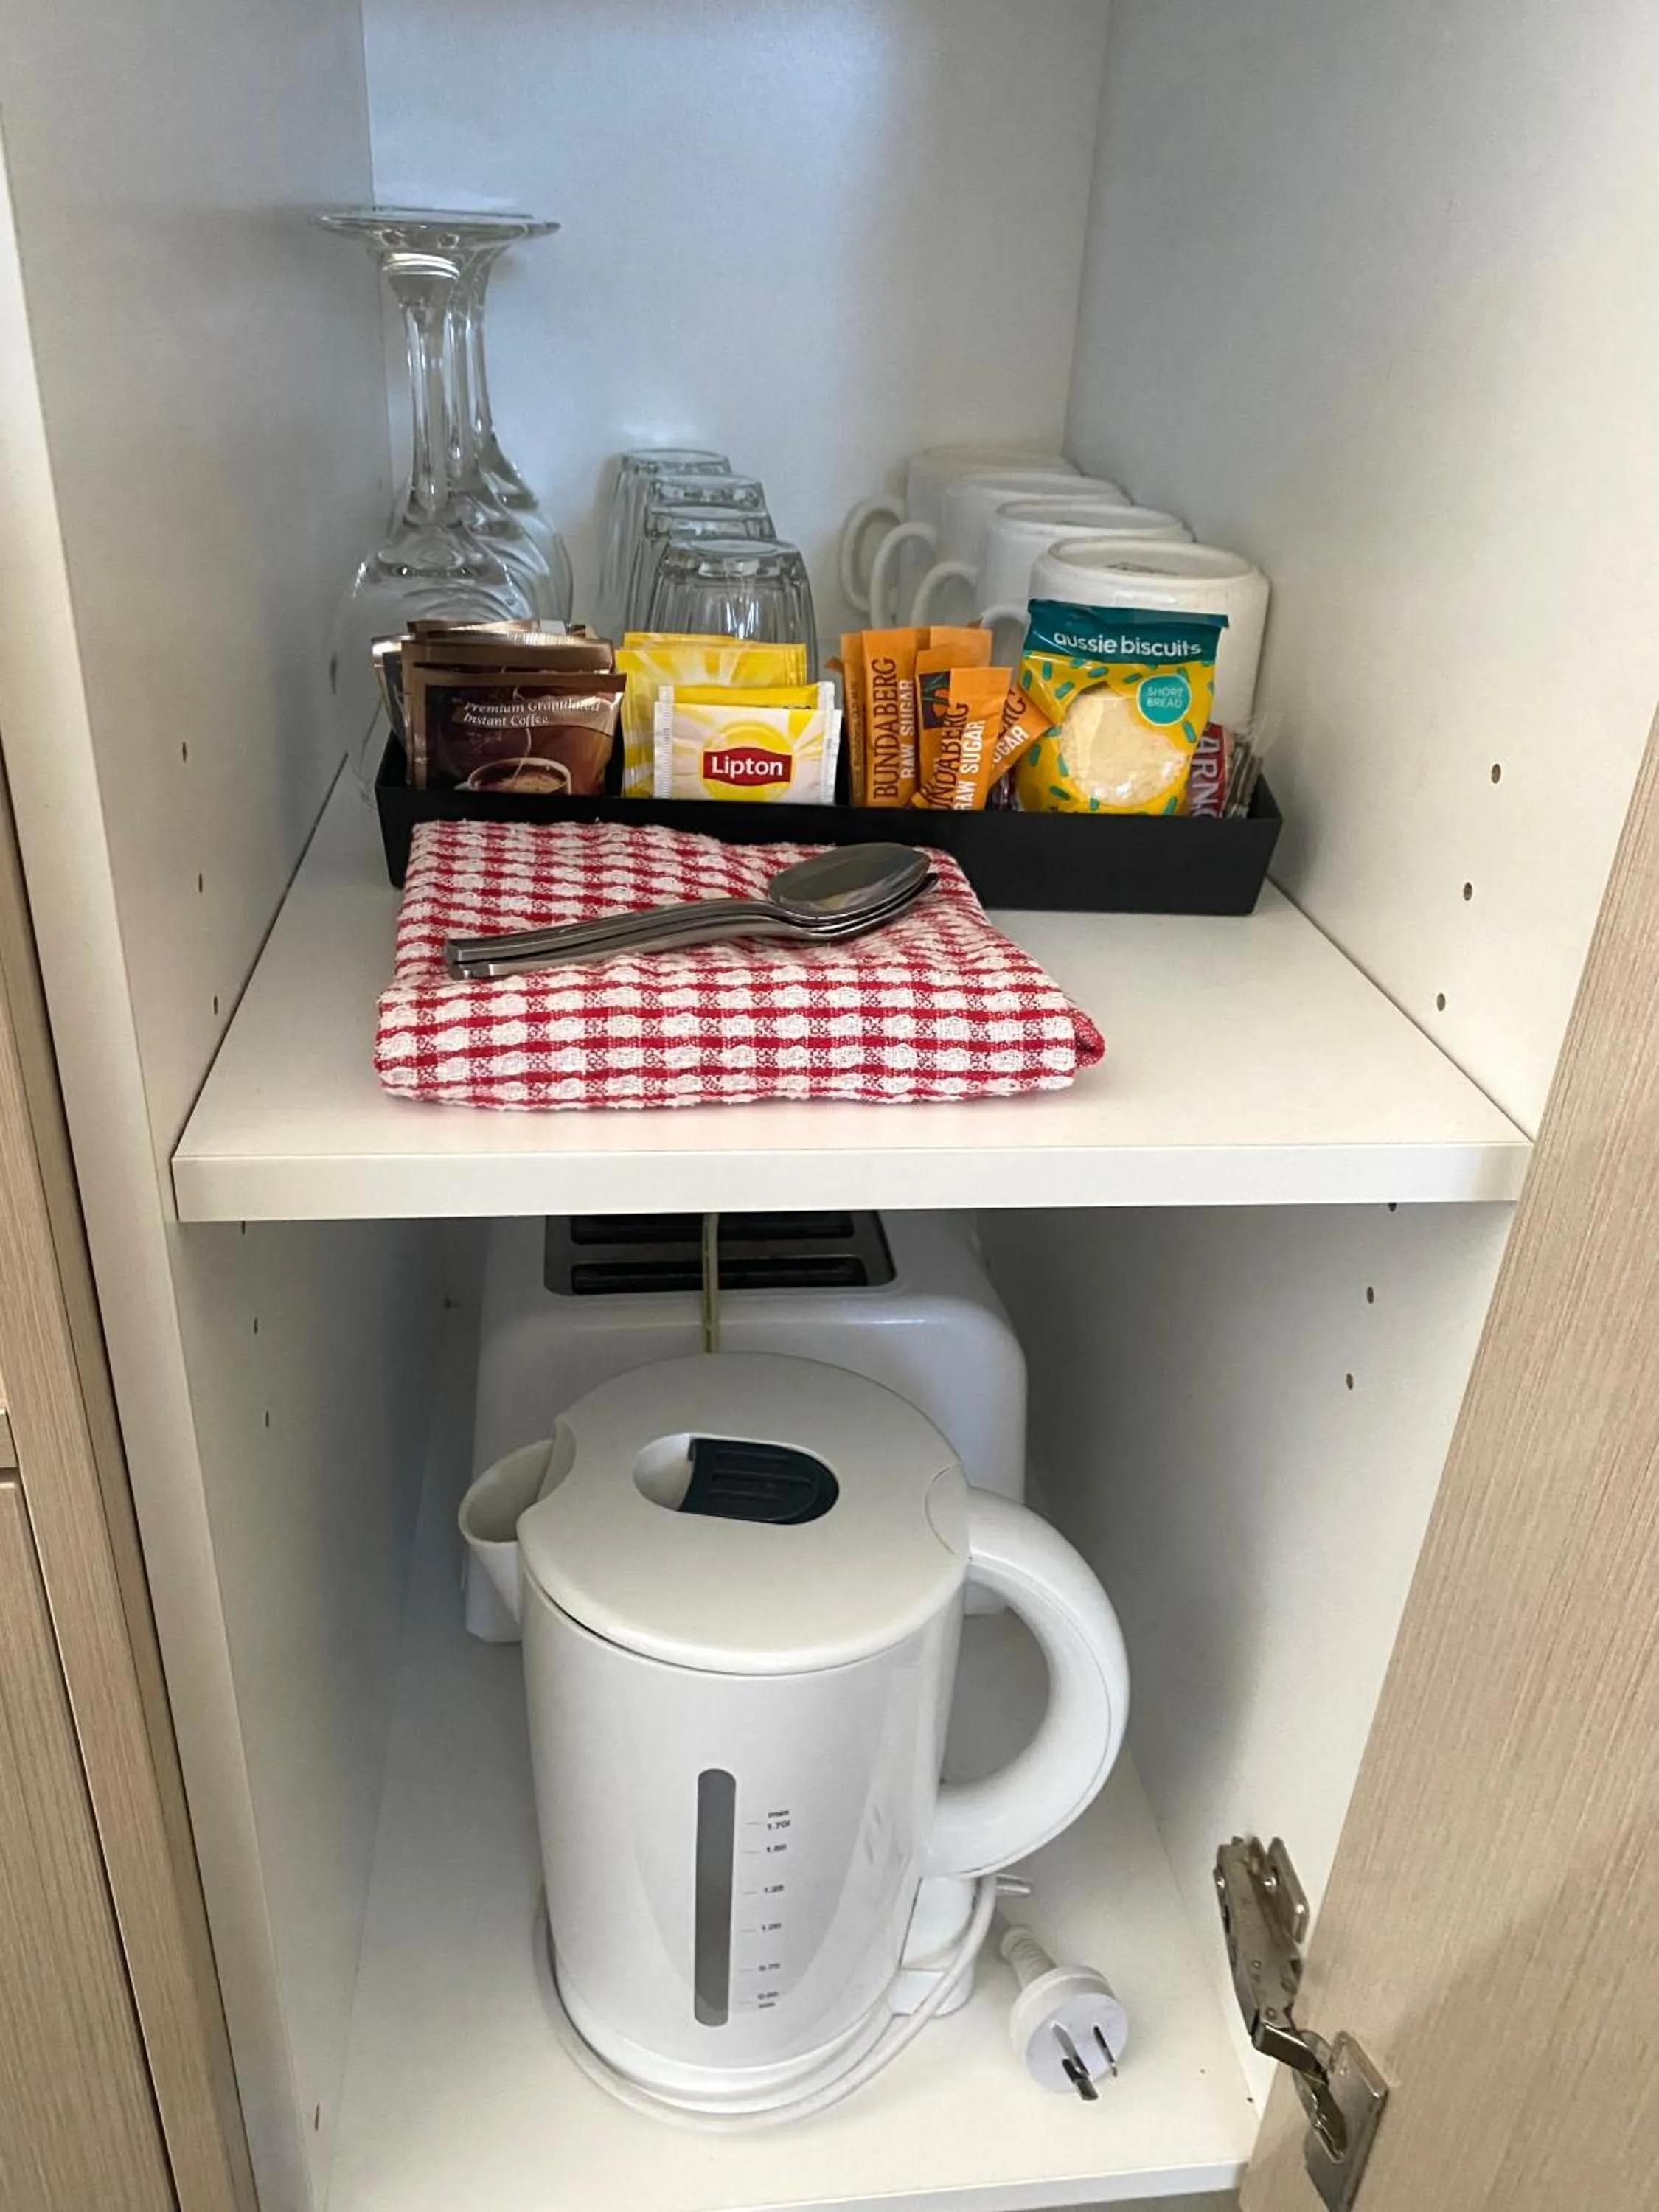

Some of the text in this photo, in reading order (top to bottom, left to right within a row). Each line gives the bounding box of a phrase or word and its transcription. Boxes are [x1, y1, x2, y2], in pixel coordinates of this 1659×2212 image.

[1054, 632, 1202, 656] aussie biscuits
[1147, 686, 1183, 698] SHORT
[1147, 698, 1183, 708] BREAD
[464, 701, 524, 714] Premium
[463, 714, 549, 728] Instant Coffee
[871, 657, 899, 800] BUNDABERG
[899, 679, 914, 779] RAW SUGAR
[959, 720, 986, 773] SUGAR
[992, 725, 1029, 769] UGAR
[712, 756, 783, 779] Lipton
